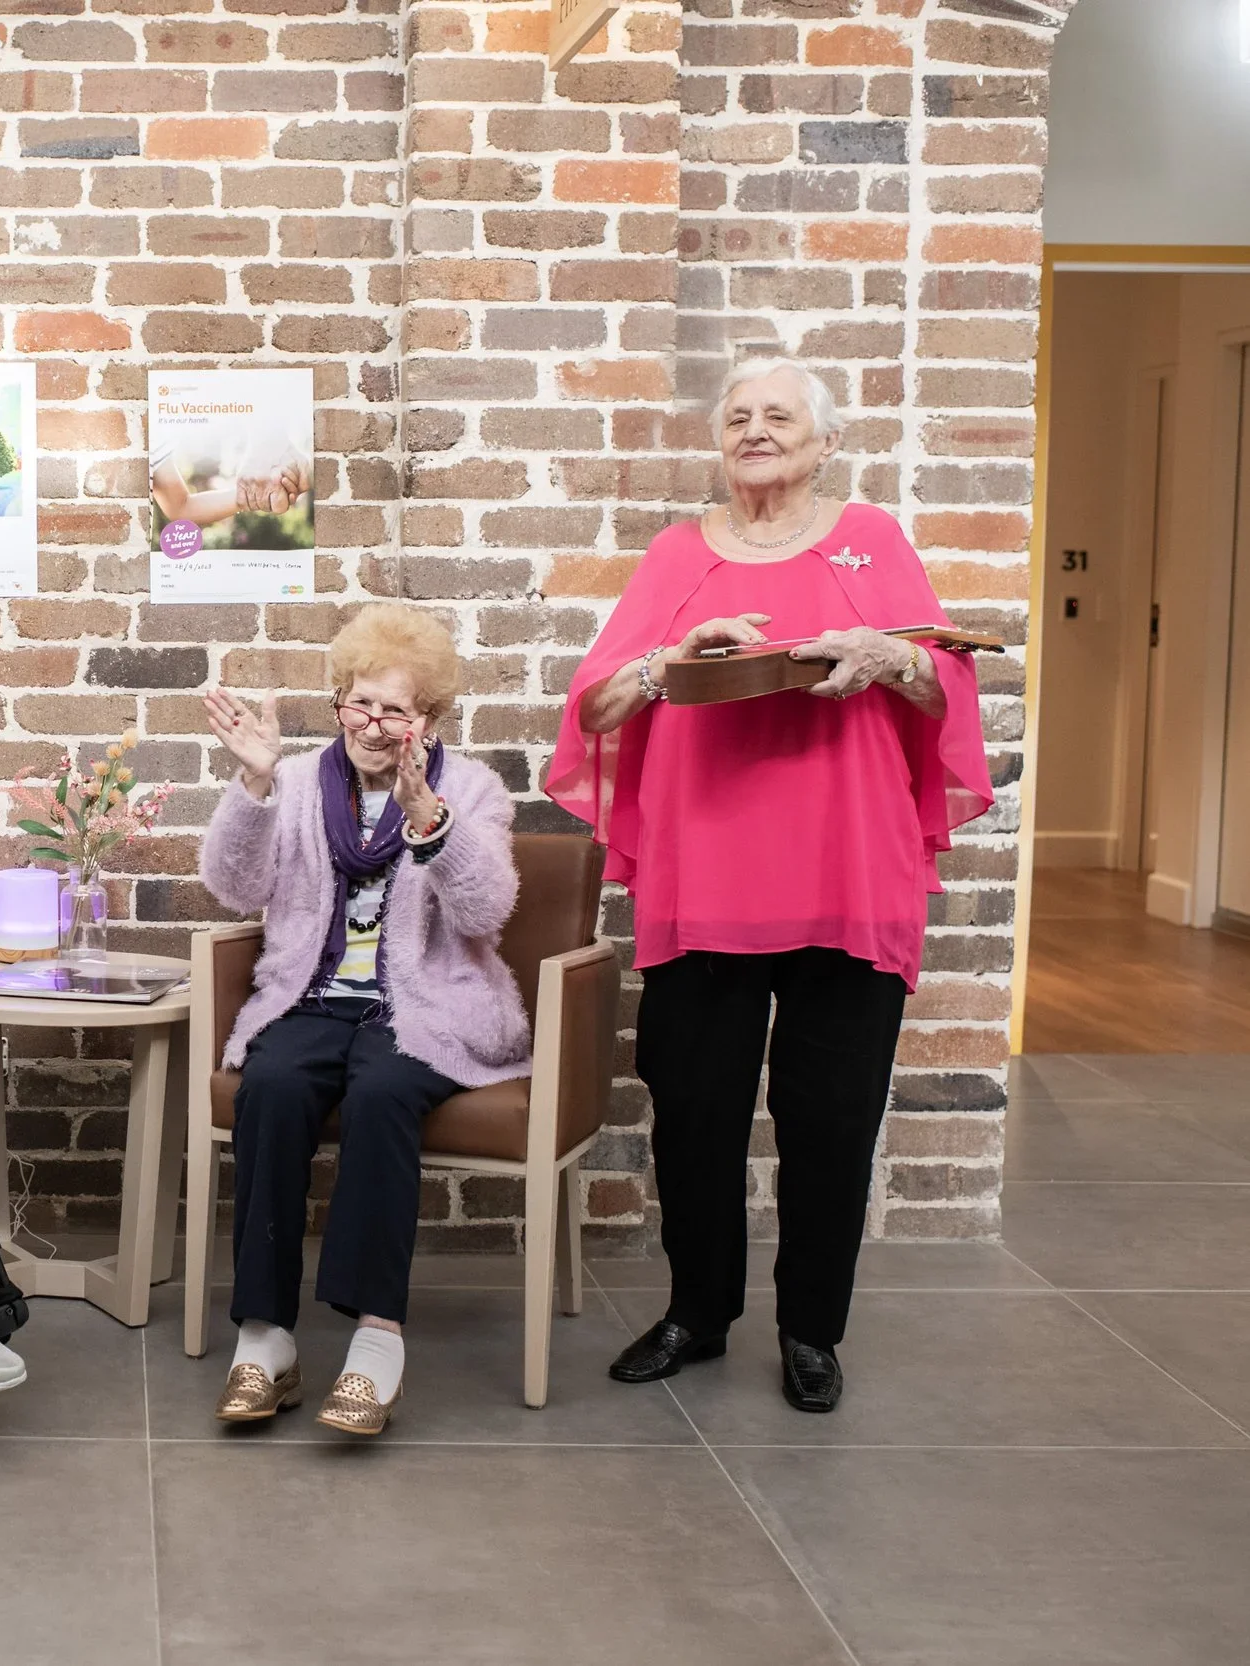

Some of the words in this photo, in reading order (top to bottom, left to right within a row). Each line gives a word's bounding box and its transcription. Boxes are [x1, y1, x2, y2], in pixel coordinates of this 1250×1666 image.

[158, 402, 179, 414] Flu
[181, 402, 253, 414] Vaccination
[164, 533, 171, 543] 2
[172, 529, 199, 542] Years
[1061, 549, 1088, 572] 31
